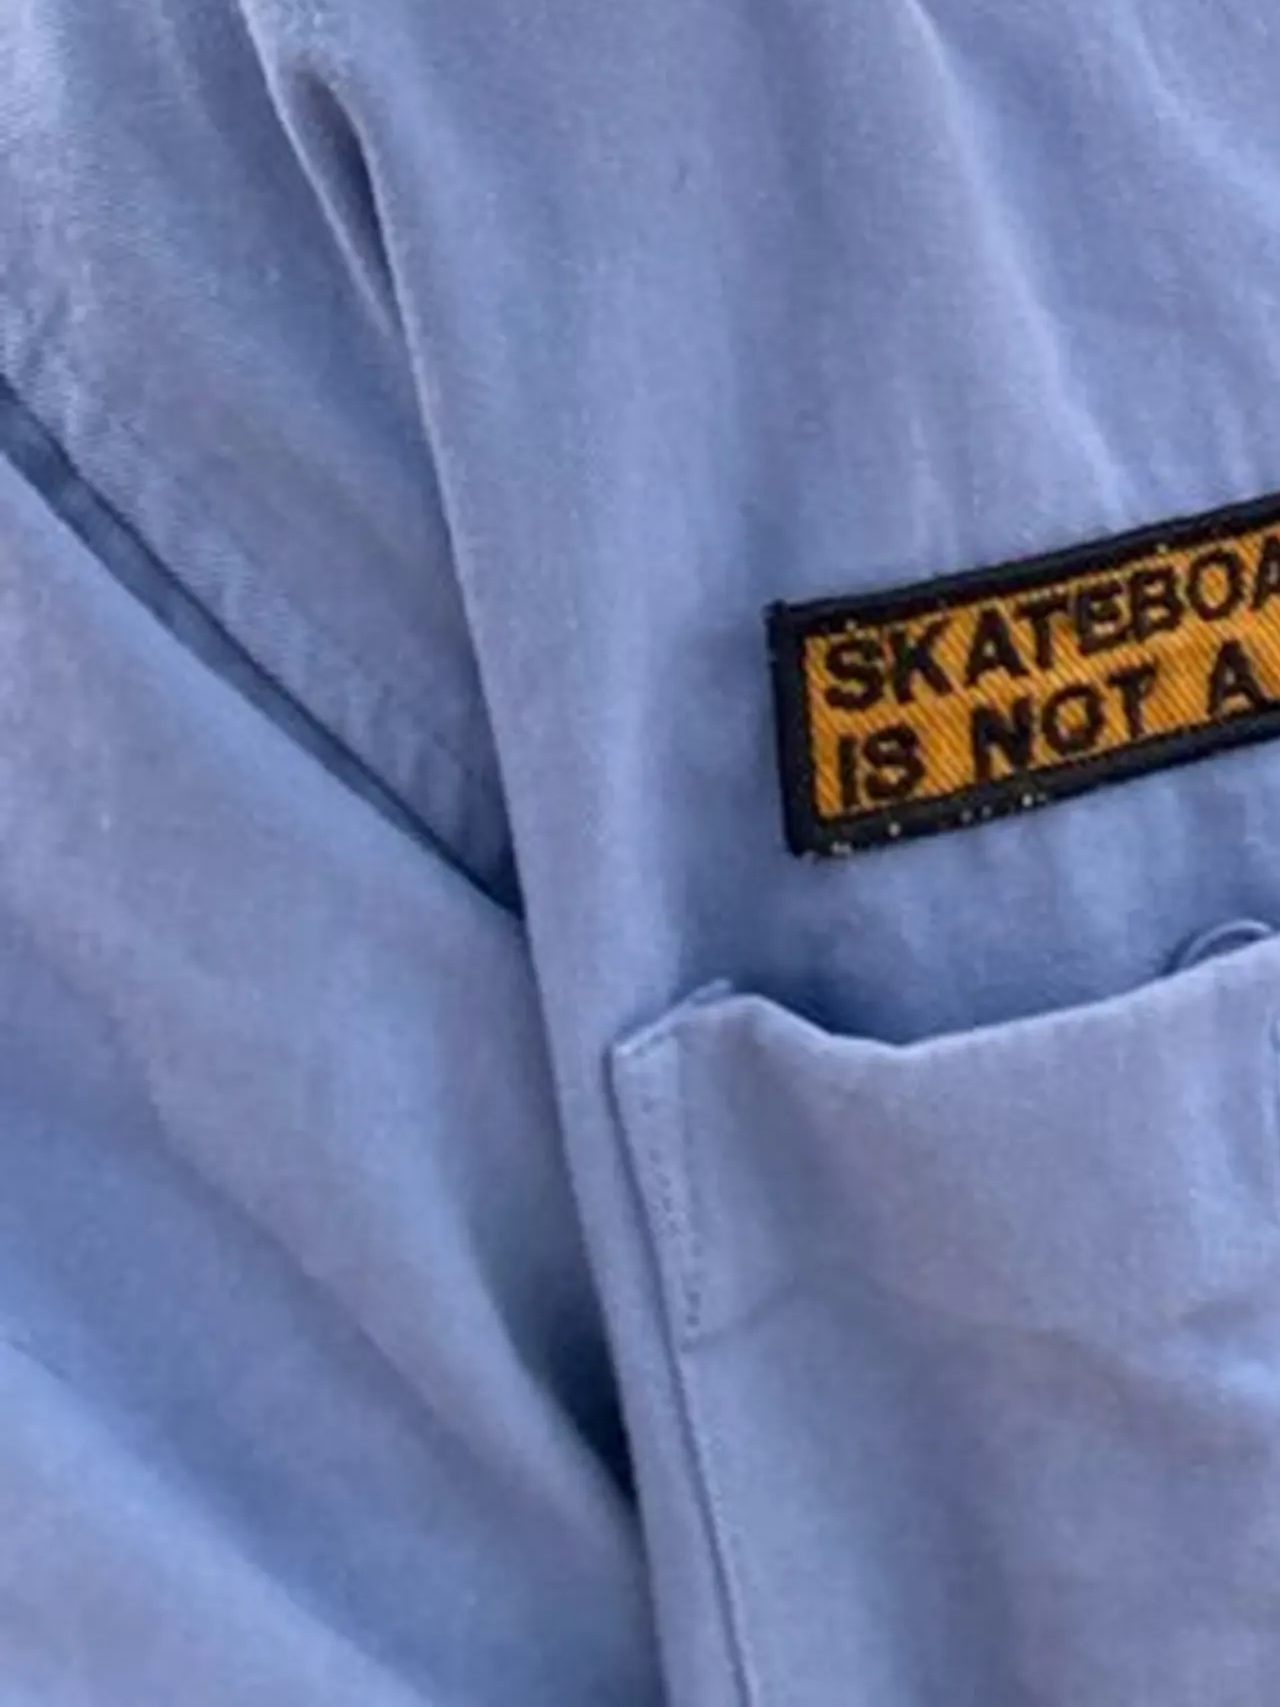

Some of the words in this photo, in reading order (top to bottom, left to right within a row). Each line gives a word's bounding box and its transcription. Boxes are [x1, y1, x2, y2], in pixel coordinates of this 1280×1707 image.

[836, 722, 926, 809] IS
[970, 664, 1159, 782] NOT
[1206, 641, 1278, 720] A
